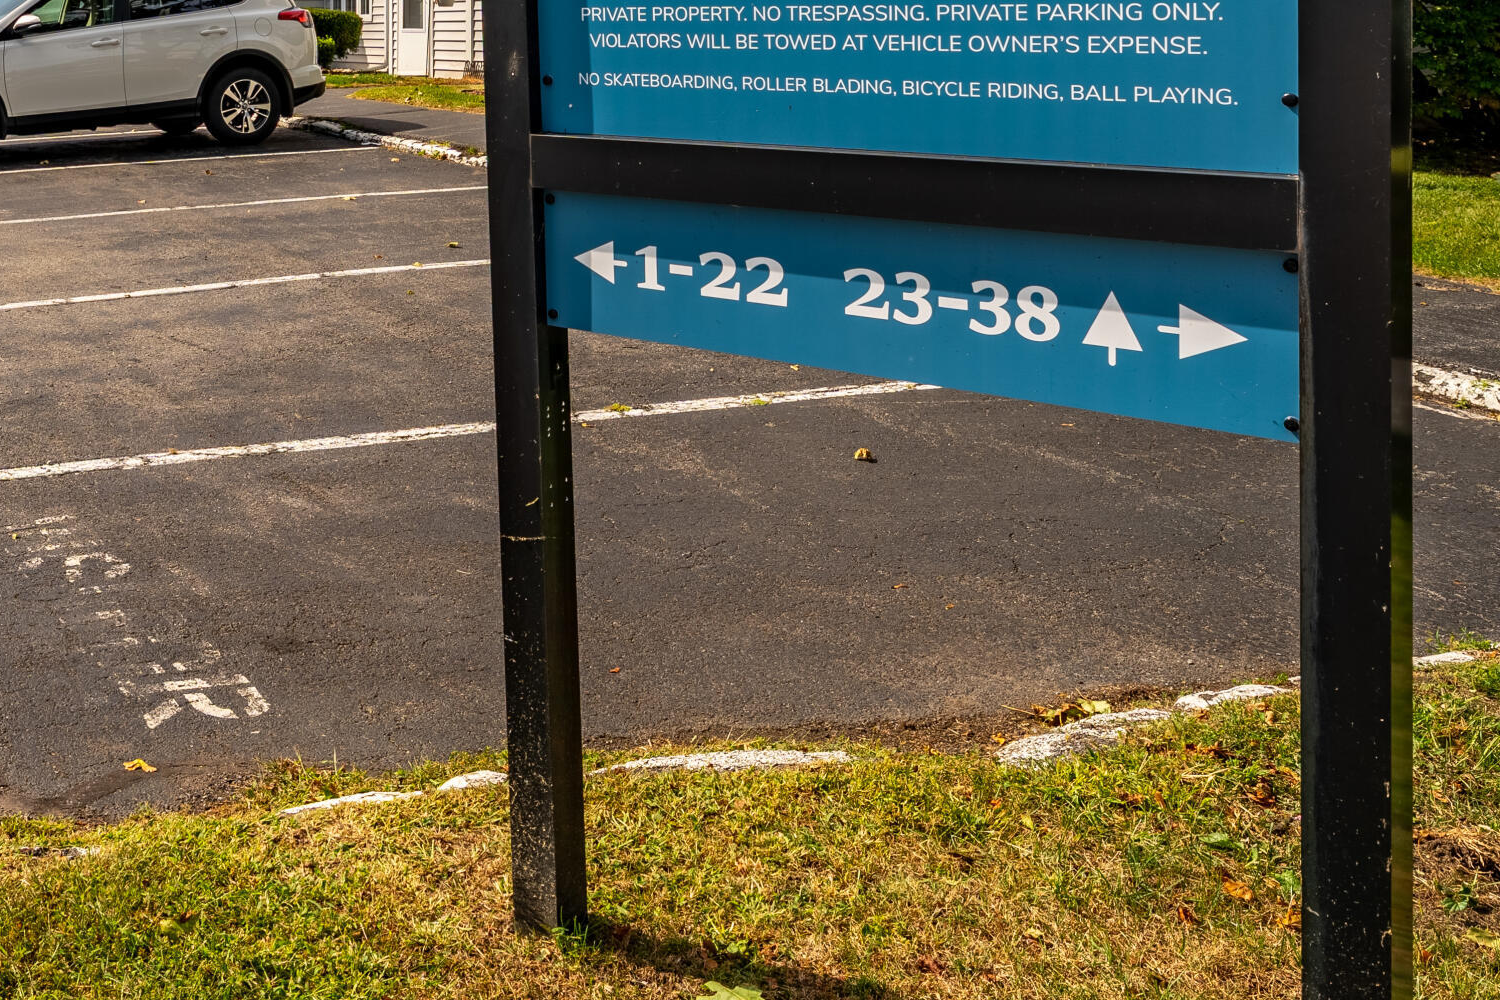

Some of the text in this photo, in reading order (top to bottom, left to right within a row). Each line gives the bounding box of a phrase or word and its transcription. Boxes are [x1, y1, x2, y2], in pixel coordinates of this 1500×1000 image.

[581, 2, 1224, 22] PRIVATE PROPERTY. NO TRESPASSING. PRIVATE PARKING ONLY.
[589, 33, 682, 49] VIOLATORS
[686, 33, 731, 50] WILL
[735, 33, 759, 50] BE
[763, 33, 837, 51] TOWED
[841, 34, 868, 51] AT
[872, 34, 962, 53] VEHICLE
[1087, 35, 1208, 55] EXPENSE.
[578, 72, 1240, 106] NO SKATEBOARDING, ROLLER BLADING, BICYCLE RIDING, BALL PLAYING.
[635, 245, 789, 308] 1-22
[843, 268, 1061, 343] 23-38
